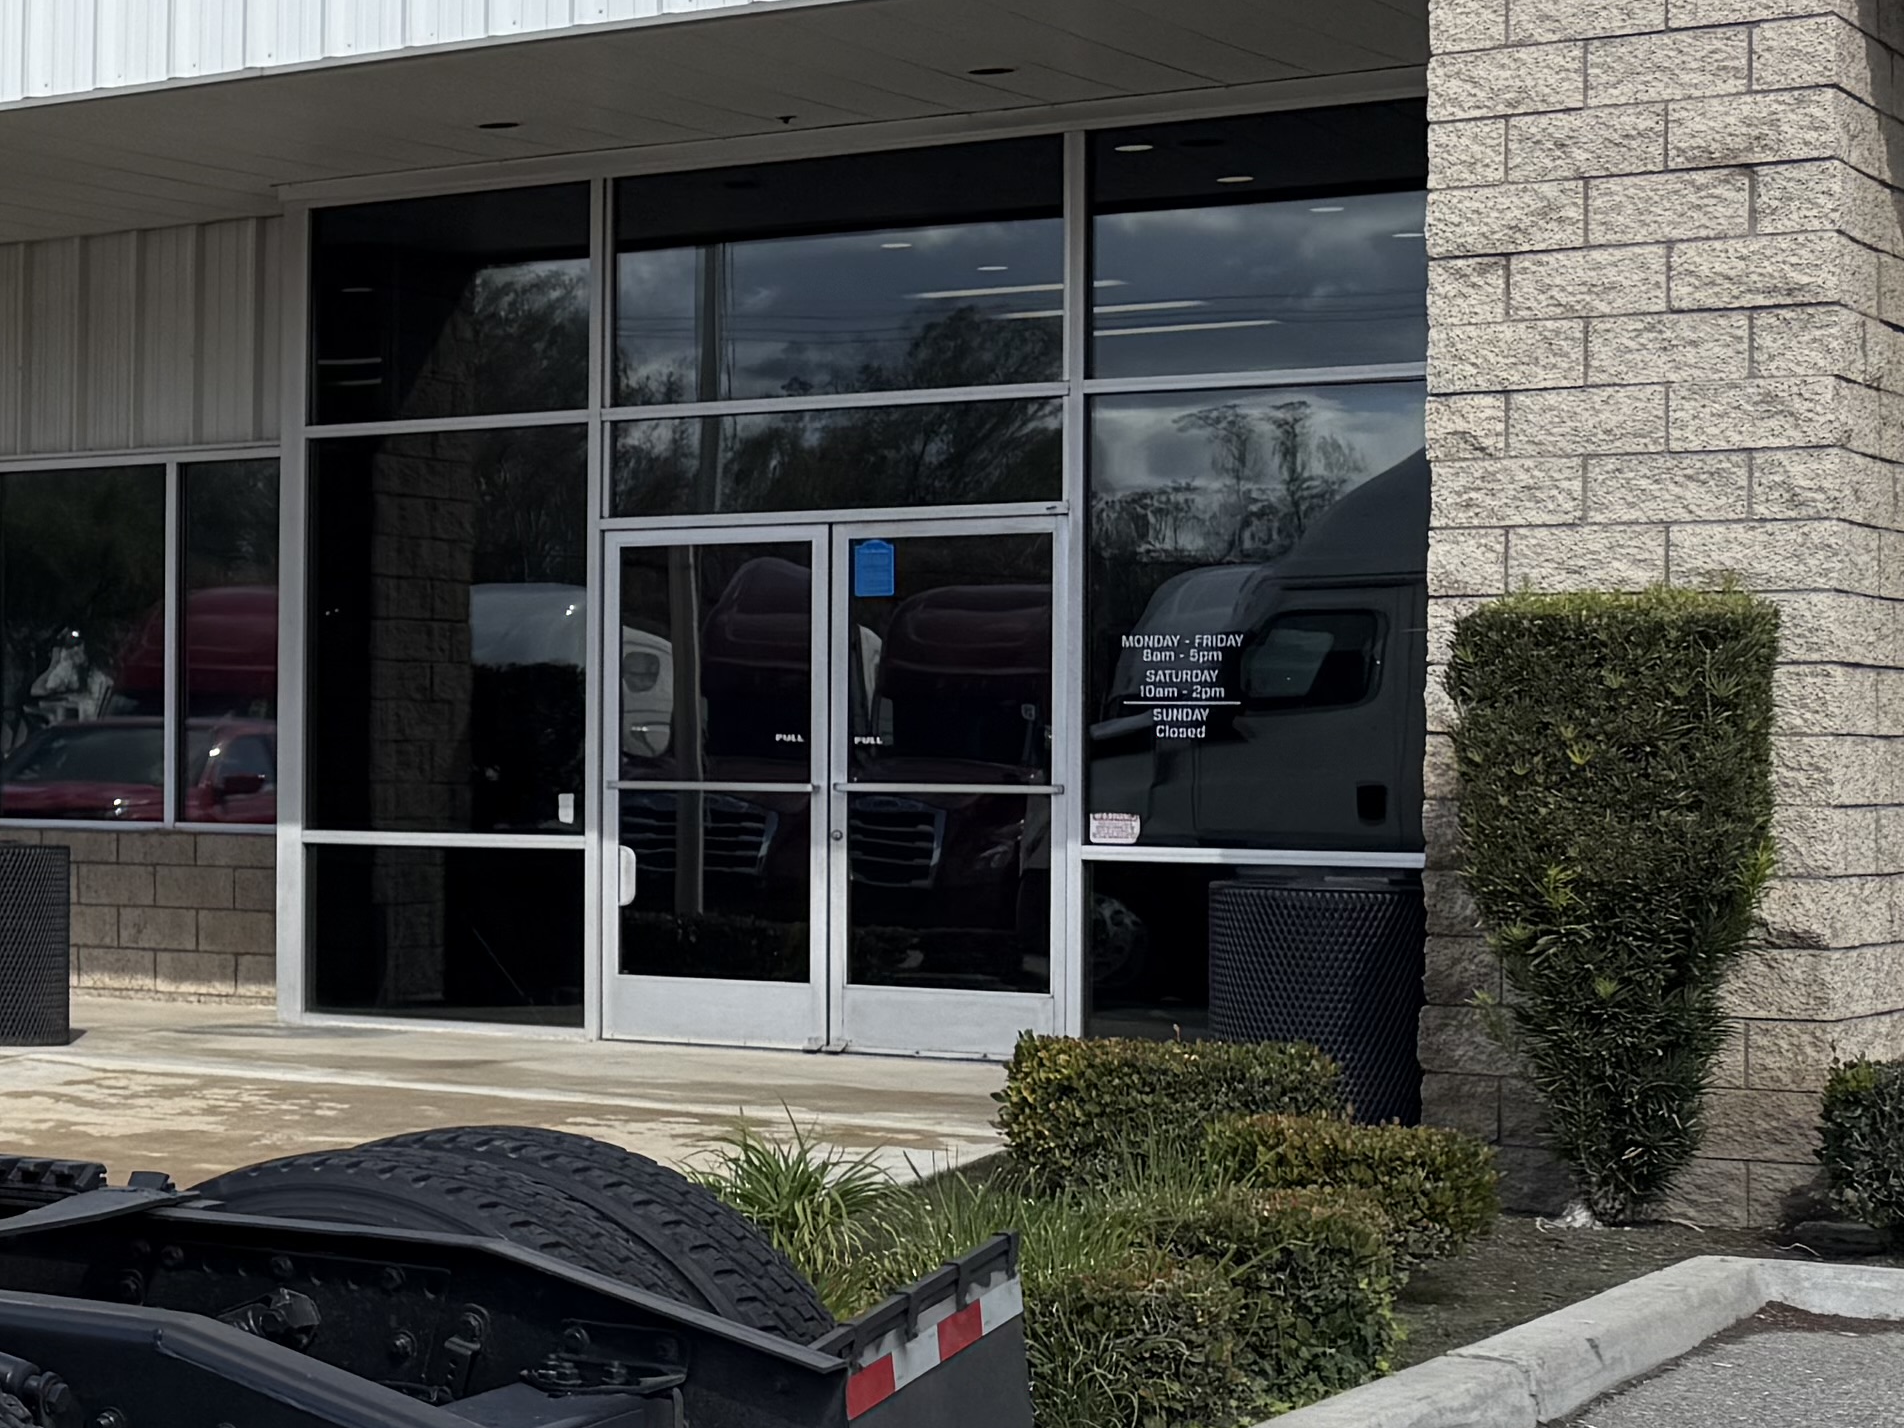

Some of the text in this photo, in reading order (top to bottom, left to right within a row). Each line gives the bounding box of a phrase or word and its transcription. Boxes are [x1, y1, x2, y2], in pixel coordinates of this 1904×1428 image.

[1121, 634, 1181, 648] MONDAY
[1194, 633, 1244, 648] FRIDAY
[1142, 648, 1175, 662] 8am
[1189, 648, 1223, 664] 5pm
[1145, 669, 1219, 683] SATURDAY
[1139, 684, 1178, 698] 10am
[1192, 684, 1225, 700] 2pm
[1153, 707, 1210, 722] SUNDAY
[775, 733, 805, 743] PULL
[1155, 724, 1206, 739] Closed
[854, 736, 884, 745] PULL
